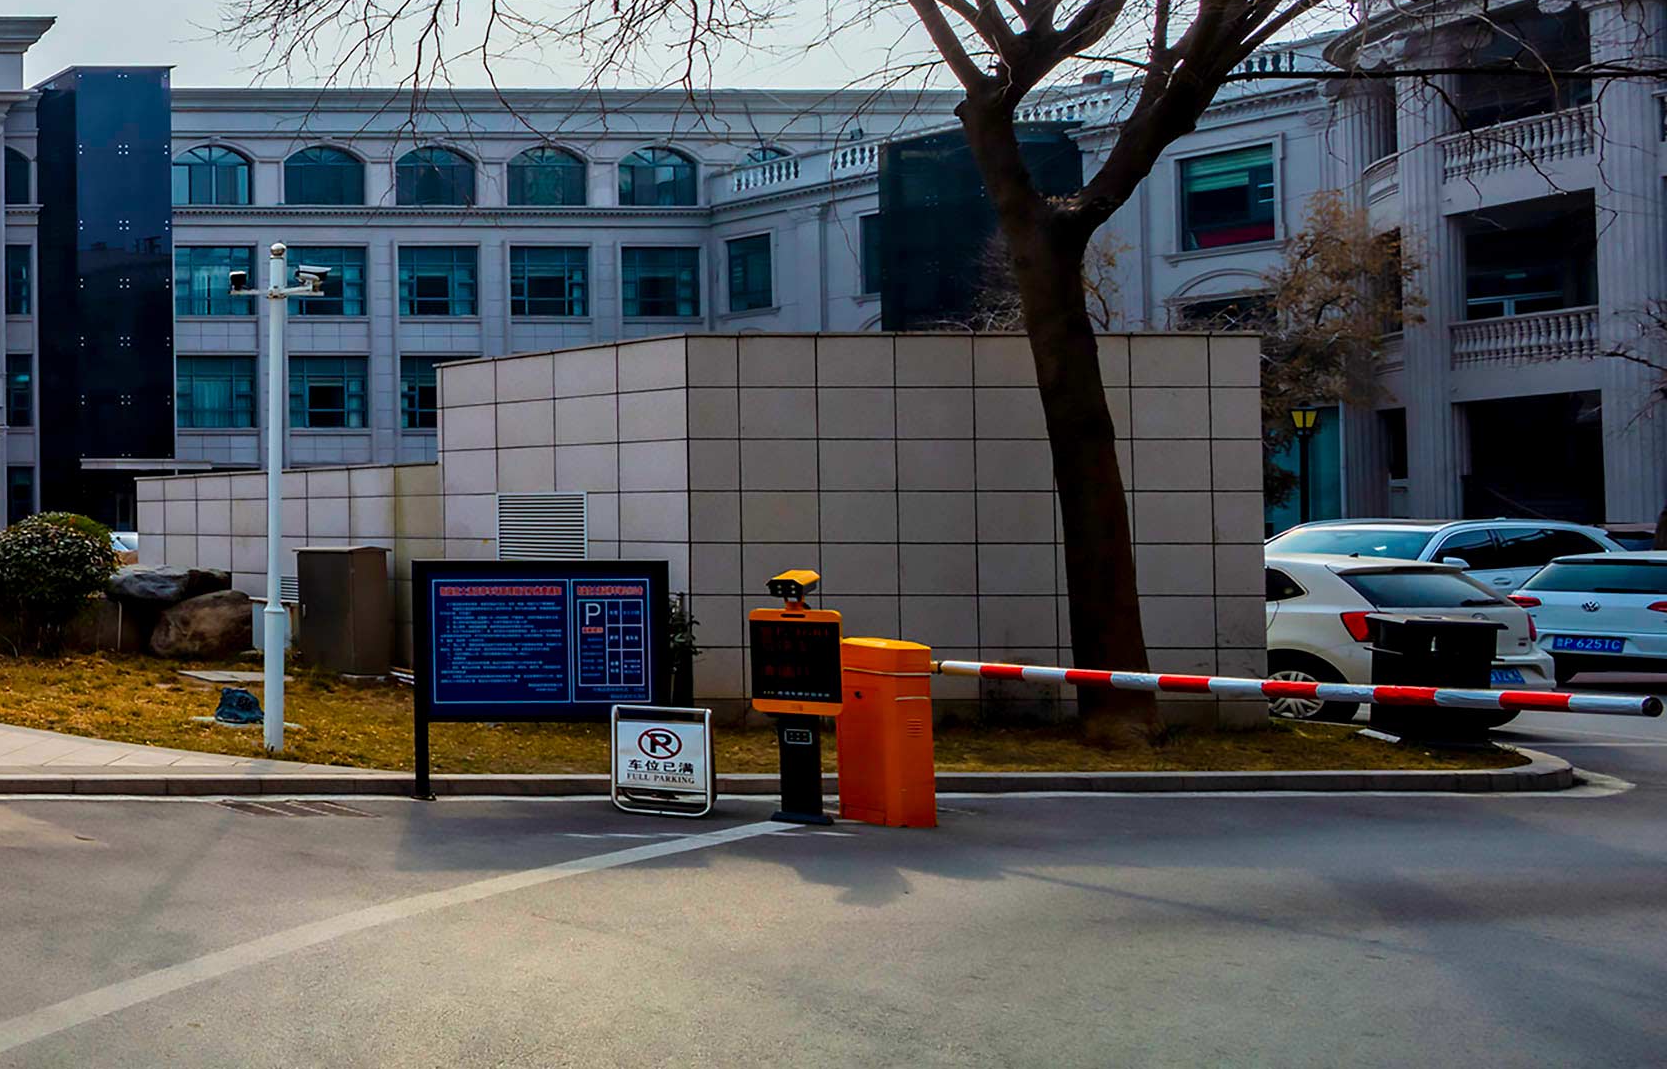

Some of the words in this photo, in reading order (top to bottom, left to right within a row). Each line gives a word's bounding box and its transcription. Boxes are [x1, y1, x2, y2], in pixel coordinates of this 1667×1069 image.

[628, 759, 694, 775] 车位已满
[627, 773, 650, 781] FULL
[653, 774, 695, 784] PARKING
